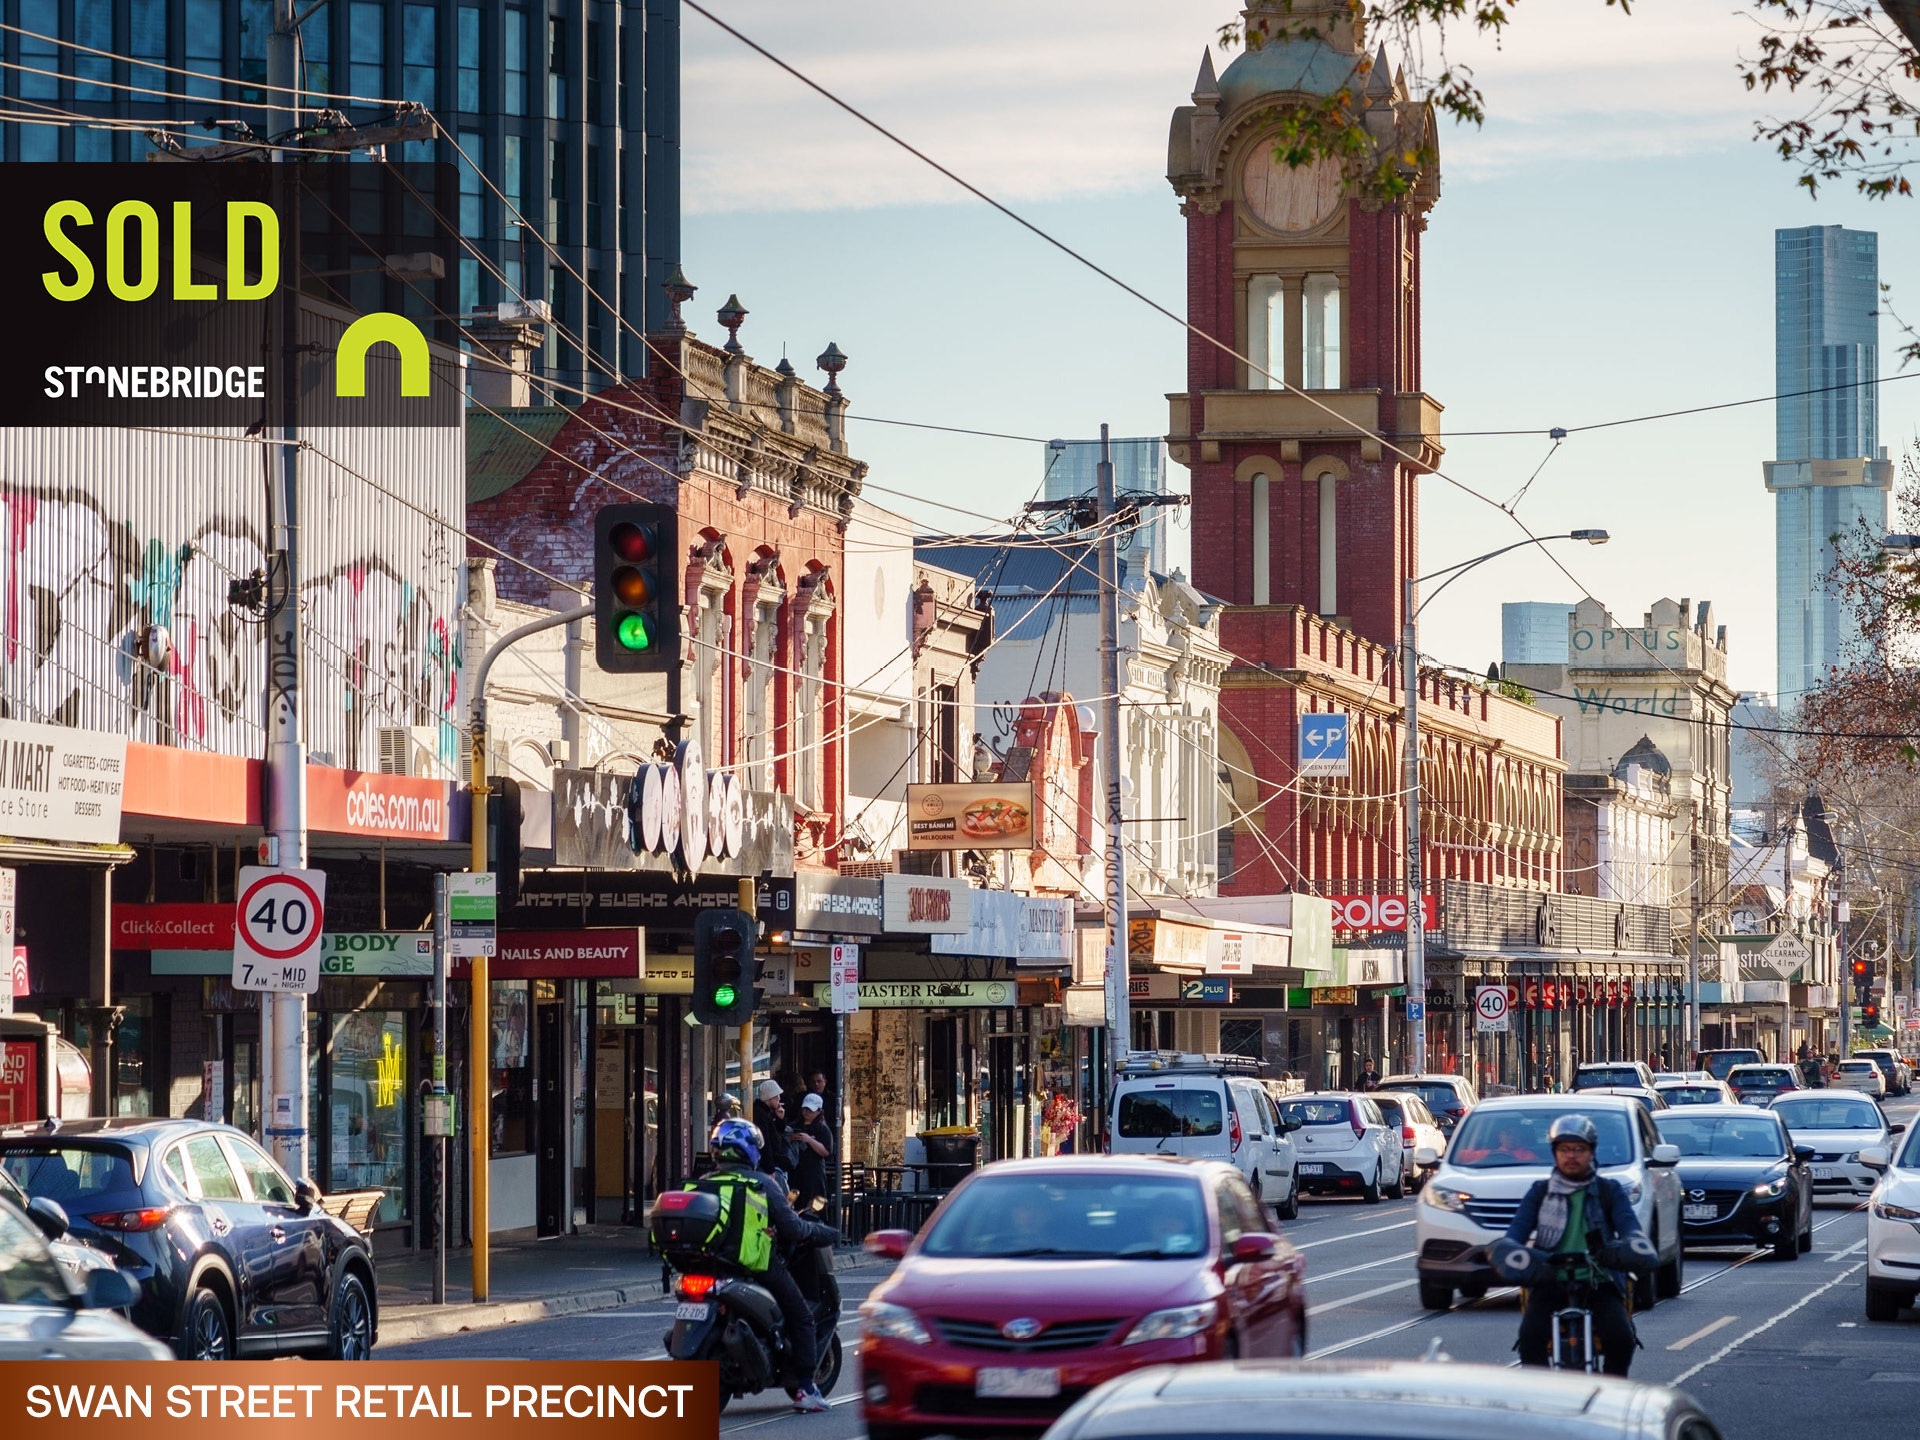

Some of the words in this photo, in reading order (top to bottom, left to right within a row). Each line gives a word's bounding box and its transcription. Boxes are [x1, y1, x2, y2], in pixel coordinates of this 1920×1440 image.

[1572, 629, 1680, 651] OPTUS
[1573, 688, 1677, 715] World
[11, 740, 54, 793] MART
[63, 753, 96, 770] CIGARETTES
[99, 758, 120, 773] COFFEE
[58, 777, 70, 791] HOT
[70, 778, 87, 793] FOOD
[89, 779, 105, 795] HEAT
[110, 783, 121, 796] EAT
[18, 797, 48, 818] Store
[74, 801, 101, 817] DESSERTS
[346, 784, 441, 833] coles.com.au
[599, 892, 668, 907] SUSHI
[250, 898, 307, 935] 40
[121, 920, 215, 935] Click&Collect
[334, 934, 401, 952] BODY
[481, 945, 494, 955] 10
[501, 948, 542, 960] NAILS
[544, 948, 574, 960] AND
[577, 946, 629, 959] BEAUTY
[1765, 949, 1806, 958] CLEARANCE
[241, 964, 254, 985] 7
[254, 977, 268, 987] AM
[282, 966, 307, 982] MID
[281, 981, 306, 989] NIGHT
[858, 984, 925, 997] MASTER
[1204, 985, 1224, 994] PLUS
[1411, 1003, 1419, 1012] P
[1480, 996, 1503, 1012] 40
